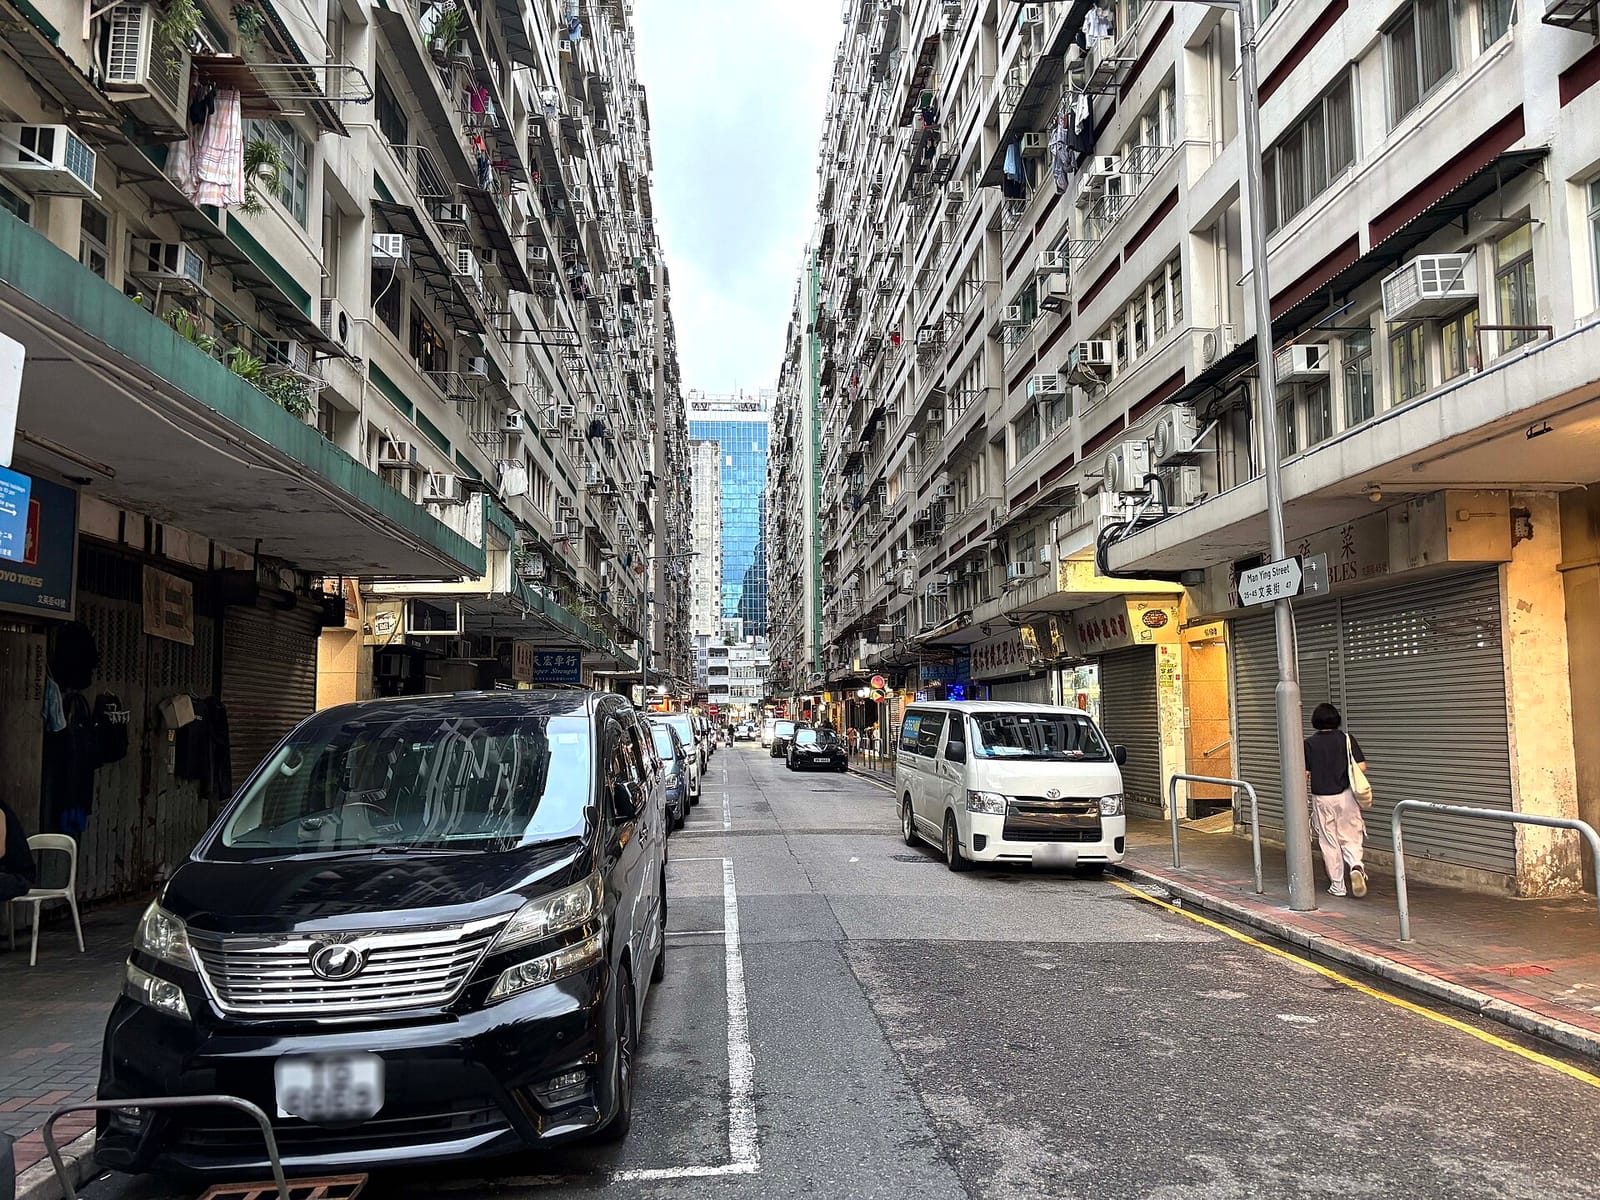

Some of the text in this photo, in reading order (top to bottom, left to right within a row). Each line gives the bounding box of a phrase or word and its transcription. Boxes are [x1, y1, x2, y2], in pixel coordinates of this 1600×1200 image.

[0, 570, 43, 588] OYO TIRES
[1246, 564, 1290, 583] Man Ying Street
[1259, 582, 1281, 599] 文英街
[1285, 581, 1292, 589] 47
[551, 667, 578, 675] Strength
